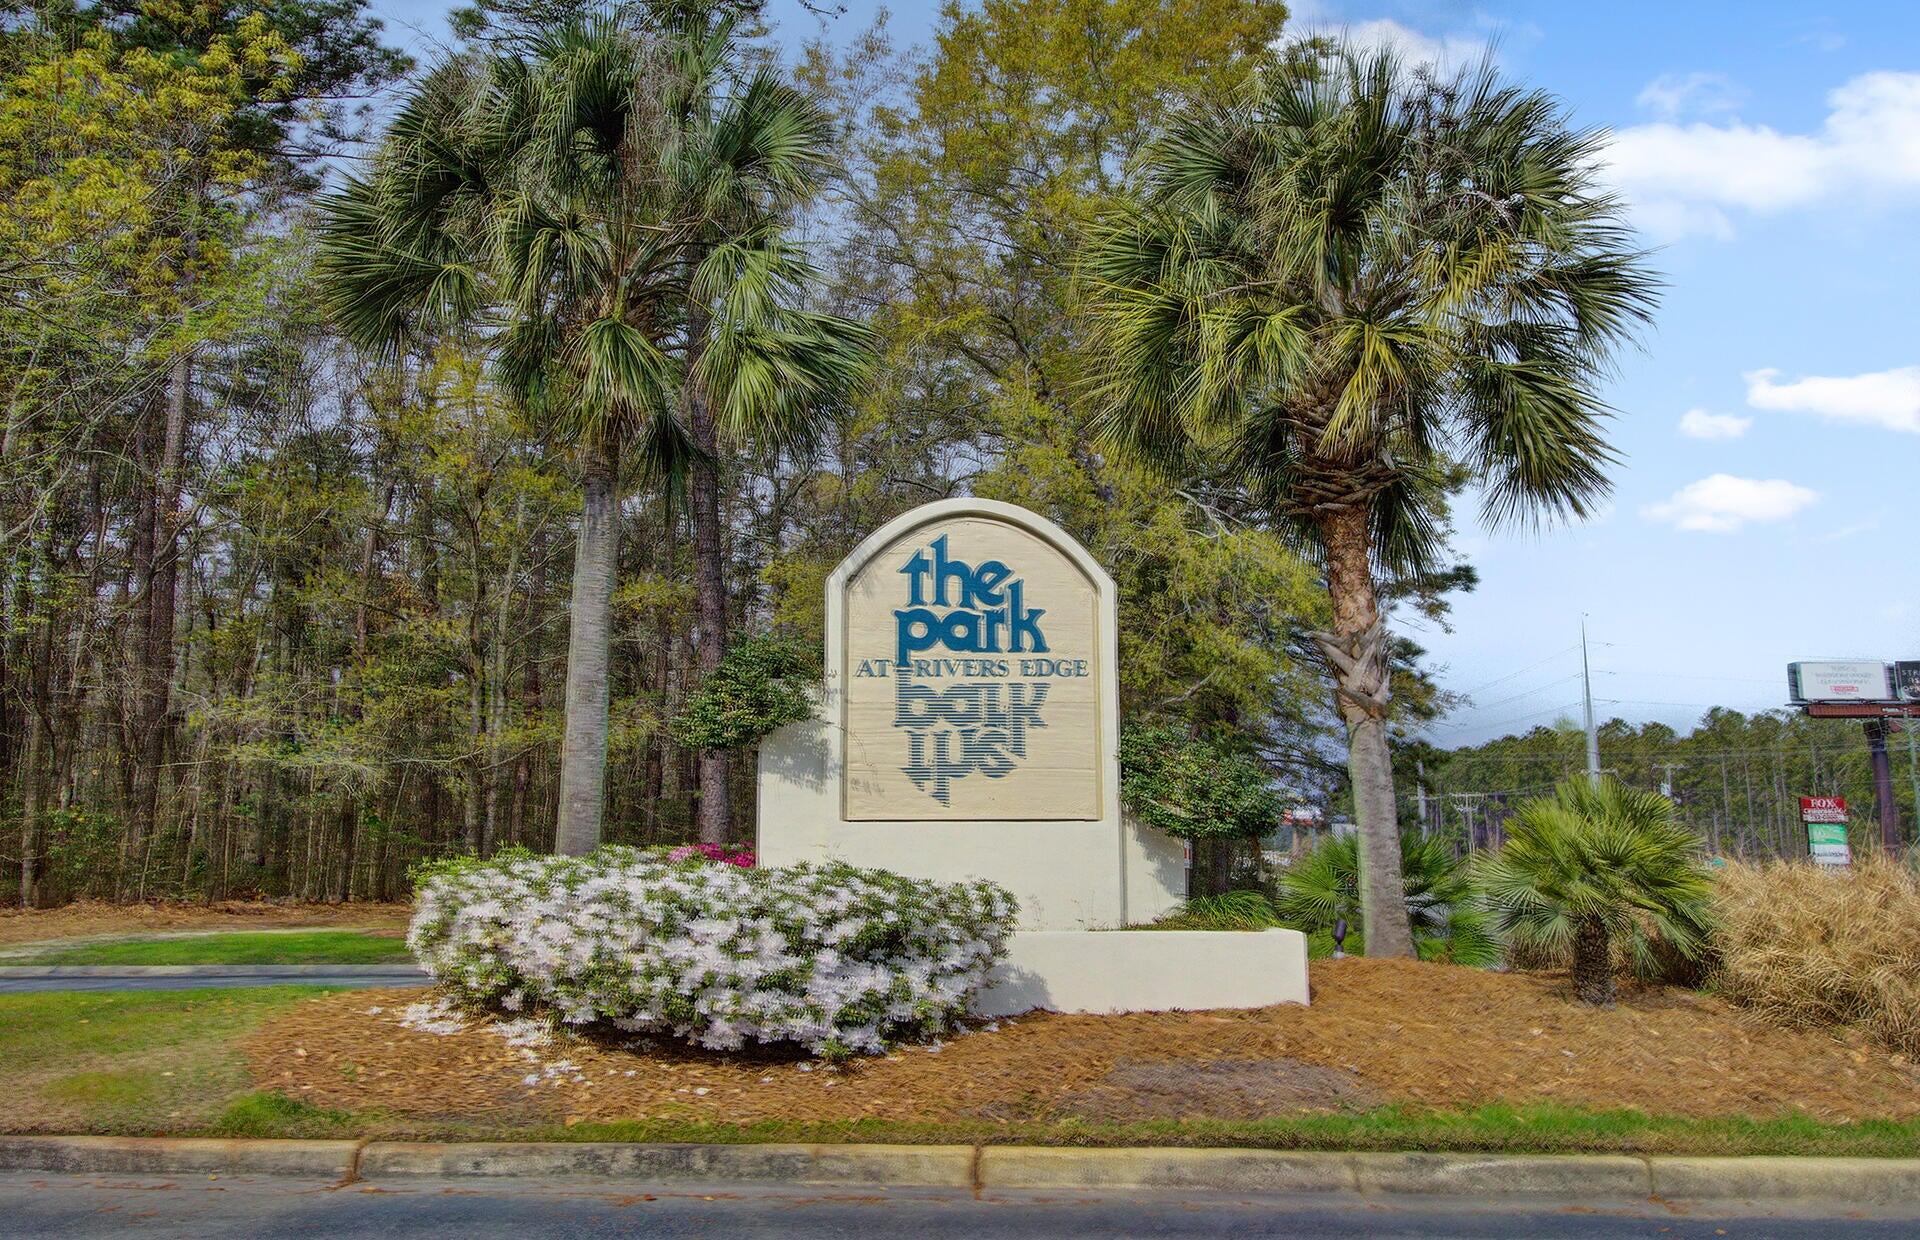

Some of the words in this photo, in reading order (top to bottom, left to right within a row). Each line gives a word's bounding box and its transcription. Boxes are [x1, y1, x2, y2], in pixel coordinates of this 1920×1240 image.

[897, 533, 1015, 608] the
[893, 578, 1050, 667] park
[853, 659, 891, 678] AT
[911, 659, 1009, 678] RIVERS
[1019, 659, 1090, 678] EDGE
